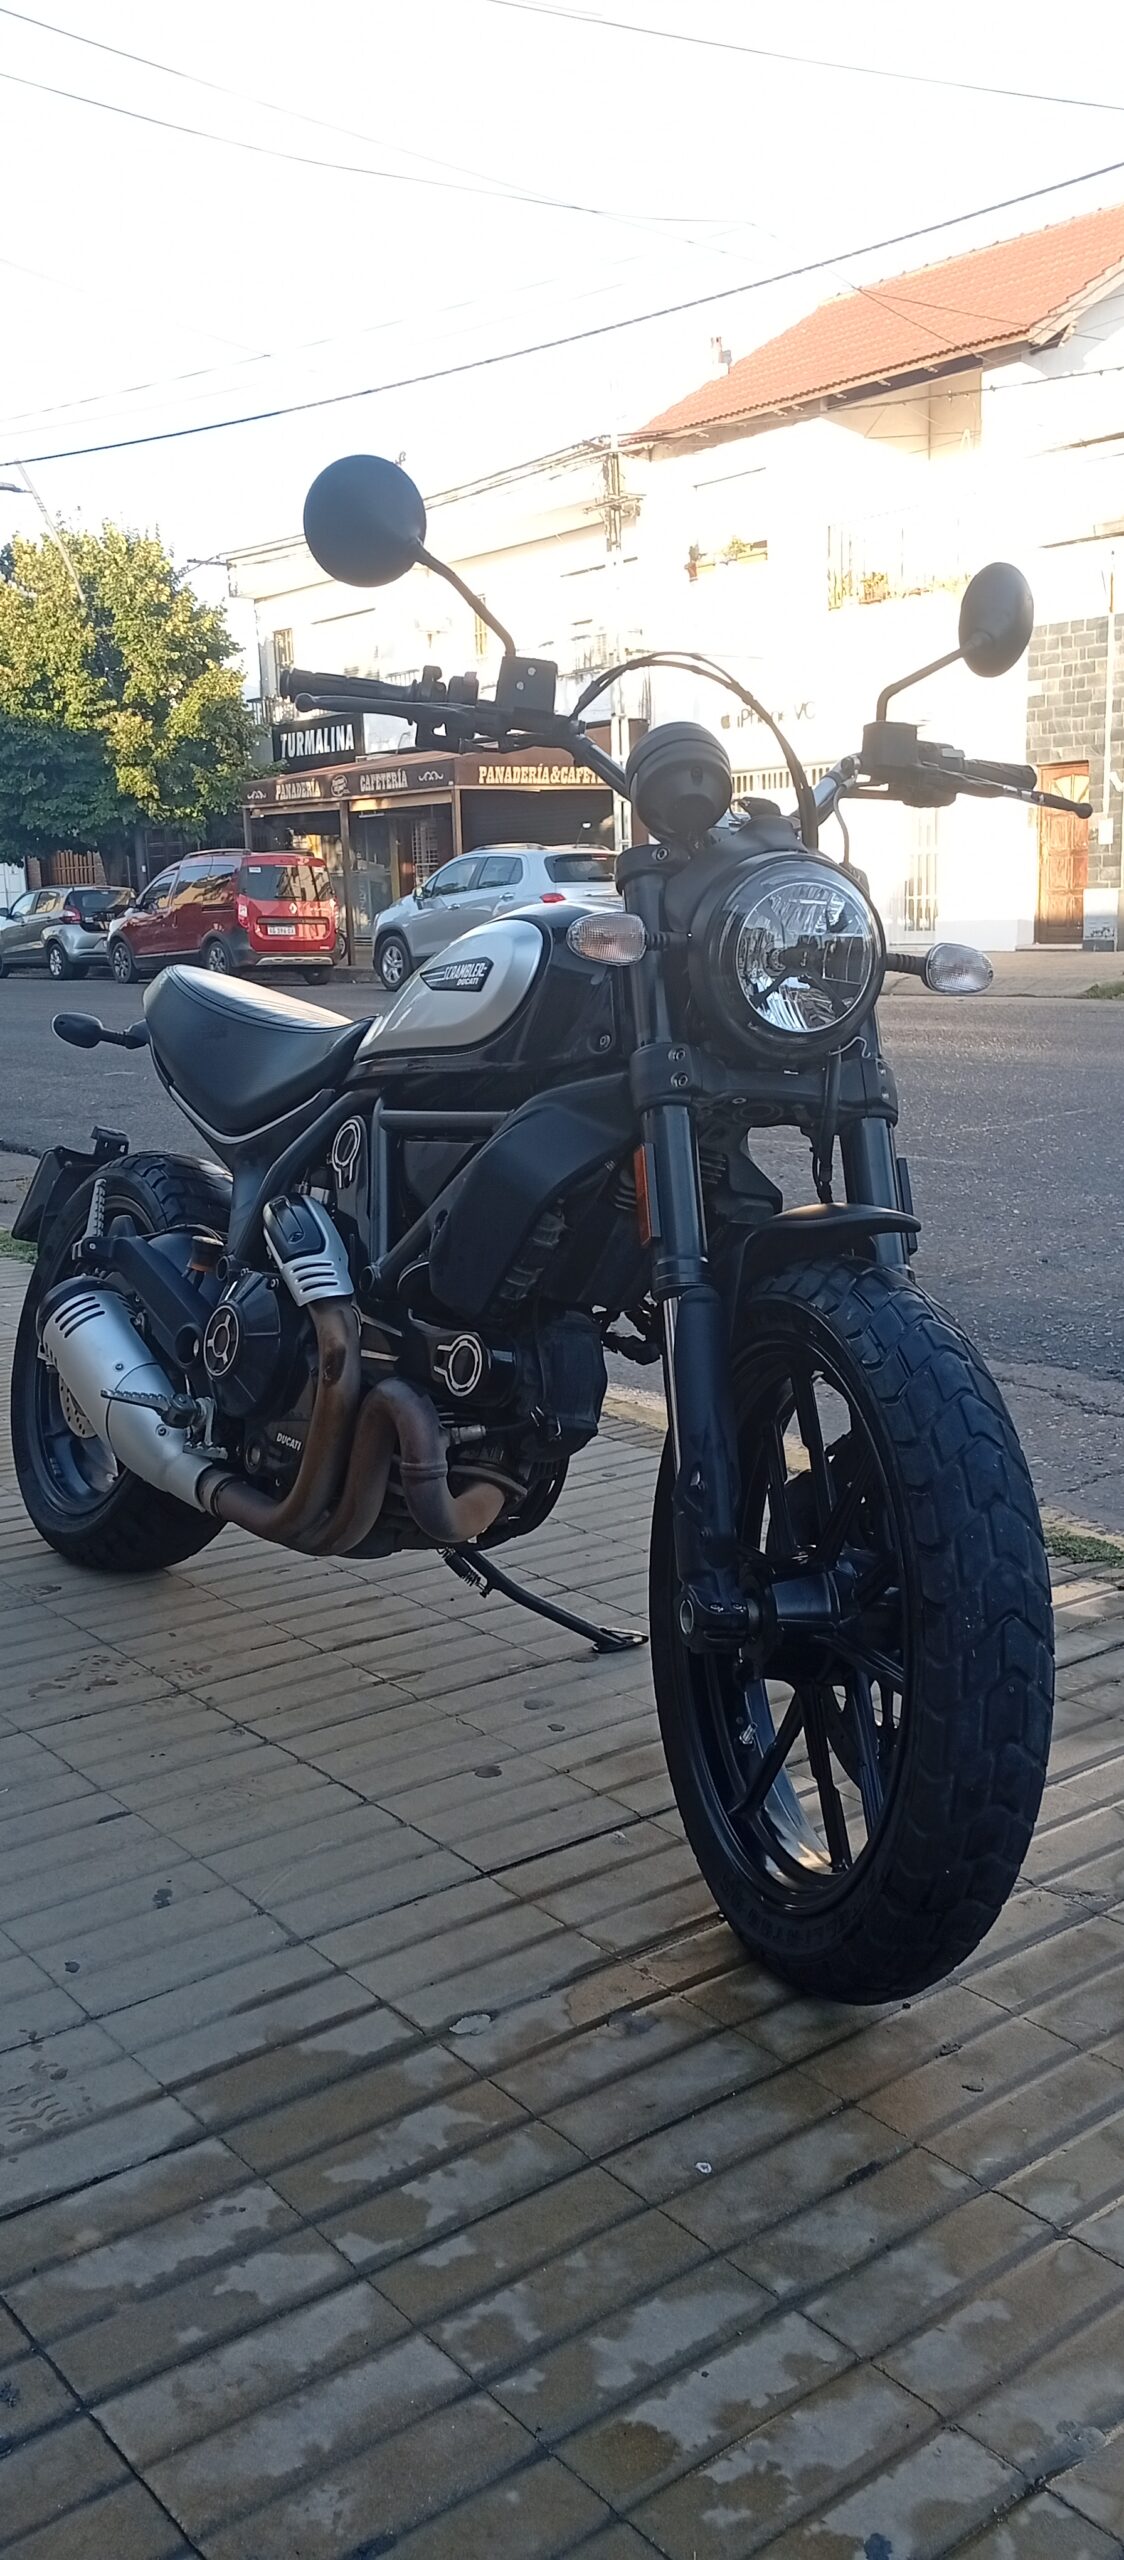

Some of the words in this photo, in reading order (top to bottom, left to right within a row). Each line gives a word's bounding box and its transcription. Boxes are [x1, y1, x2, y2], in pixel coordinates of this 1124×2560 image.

[793, 701, 816, 721] VC
[280, 724, 355, 758] TURMALINA
[275, 778, 321, 800] PANADERÍA
[360, 768, 408, 792] CAFETERÍA
[444, 962, 488, 980] SCRAMBLER
[456, 977, 480, 986] DUCATI
[276, 1432, 302, 1451] DUCATI
